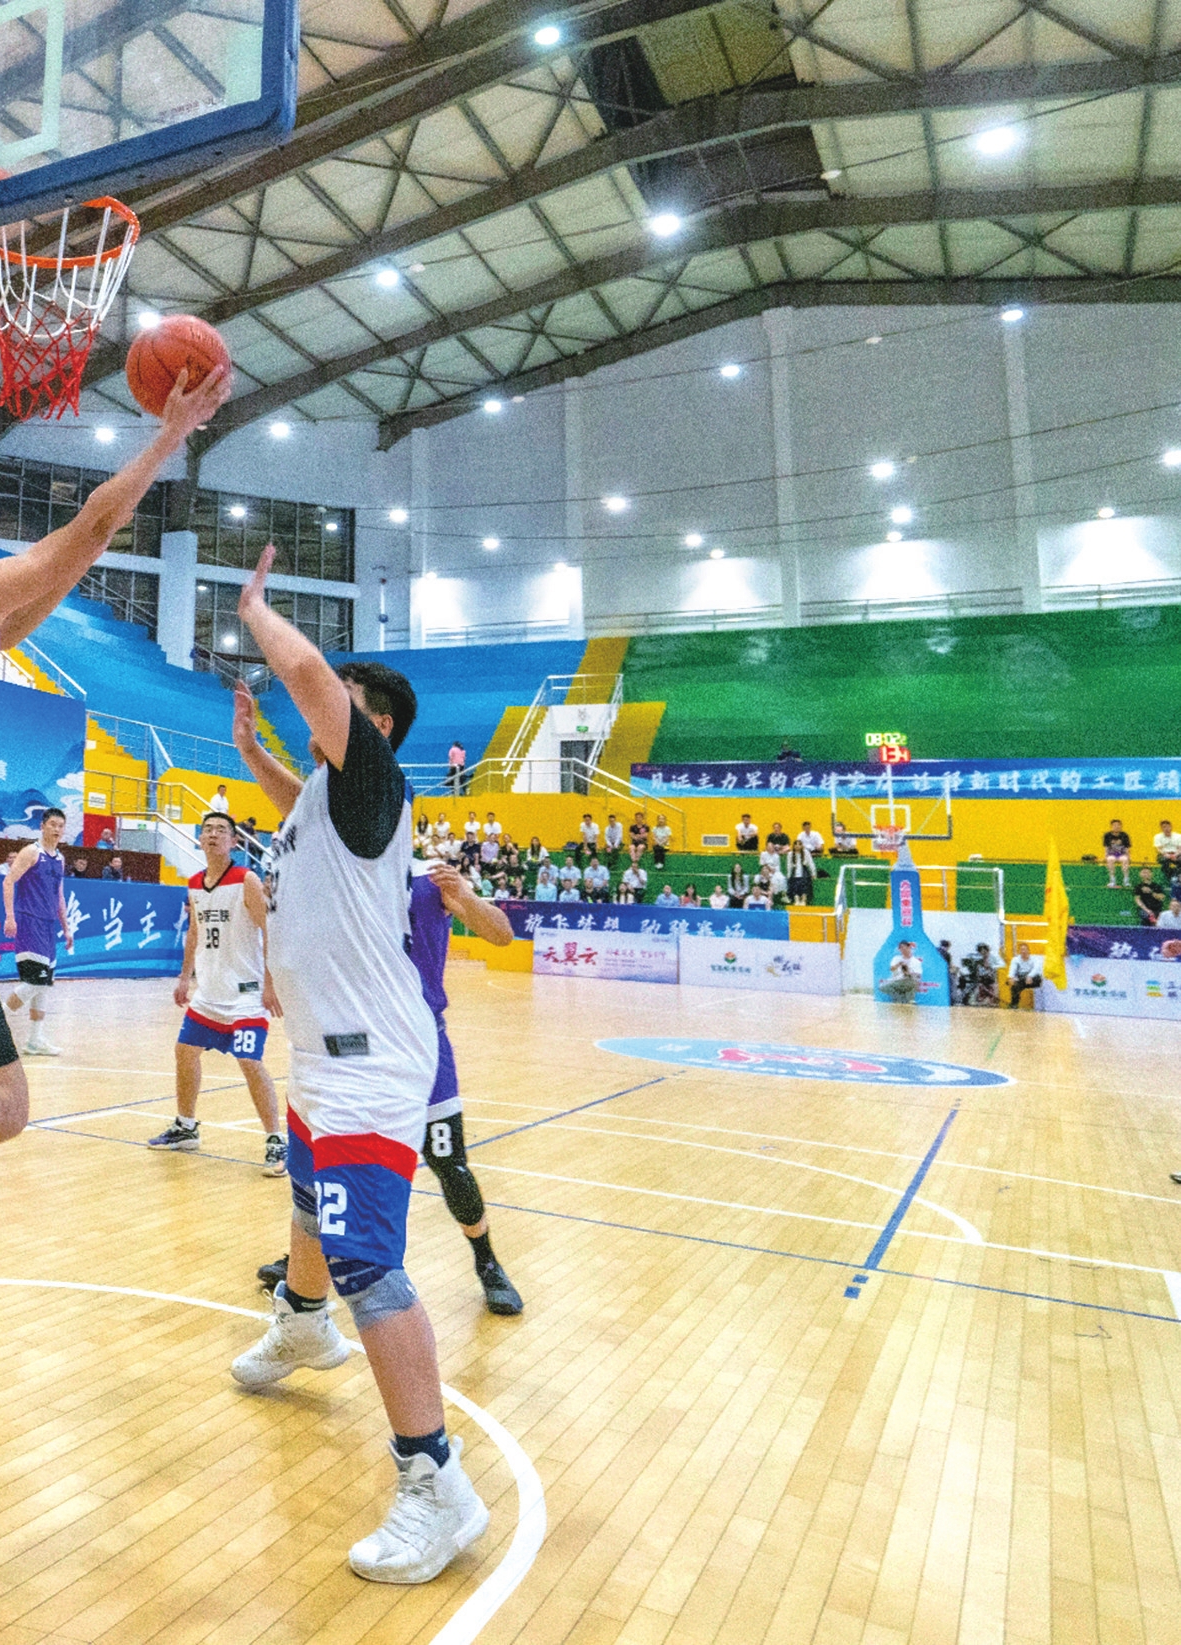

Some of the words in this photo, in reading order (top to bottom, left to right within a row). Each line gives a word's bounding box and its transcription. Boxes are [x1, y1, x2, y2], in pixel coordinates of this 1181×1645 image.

[543, 941, 598, 966] 天翼云
[233, 1029, 257, 1053] 28
[430, 1122, 453, 1157] 8
[314, 1181, 347, 1236] 2
